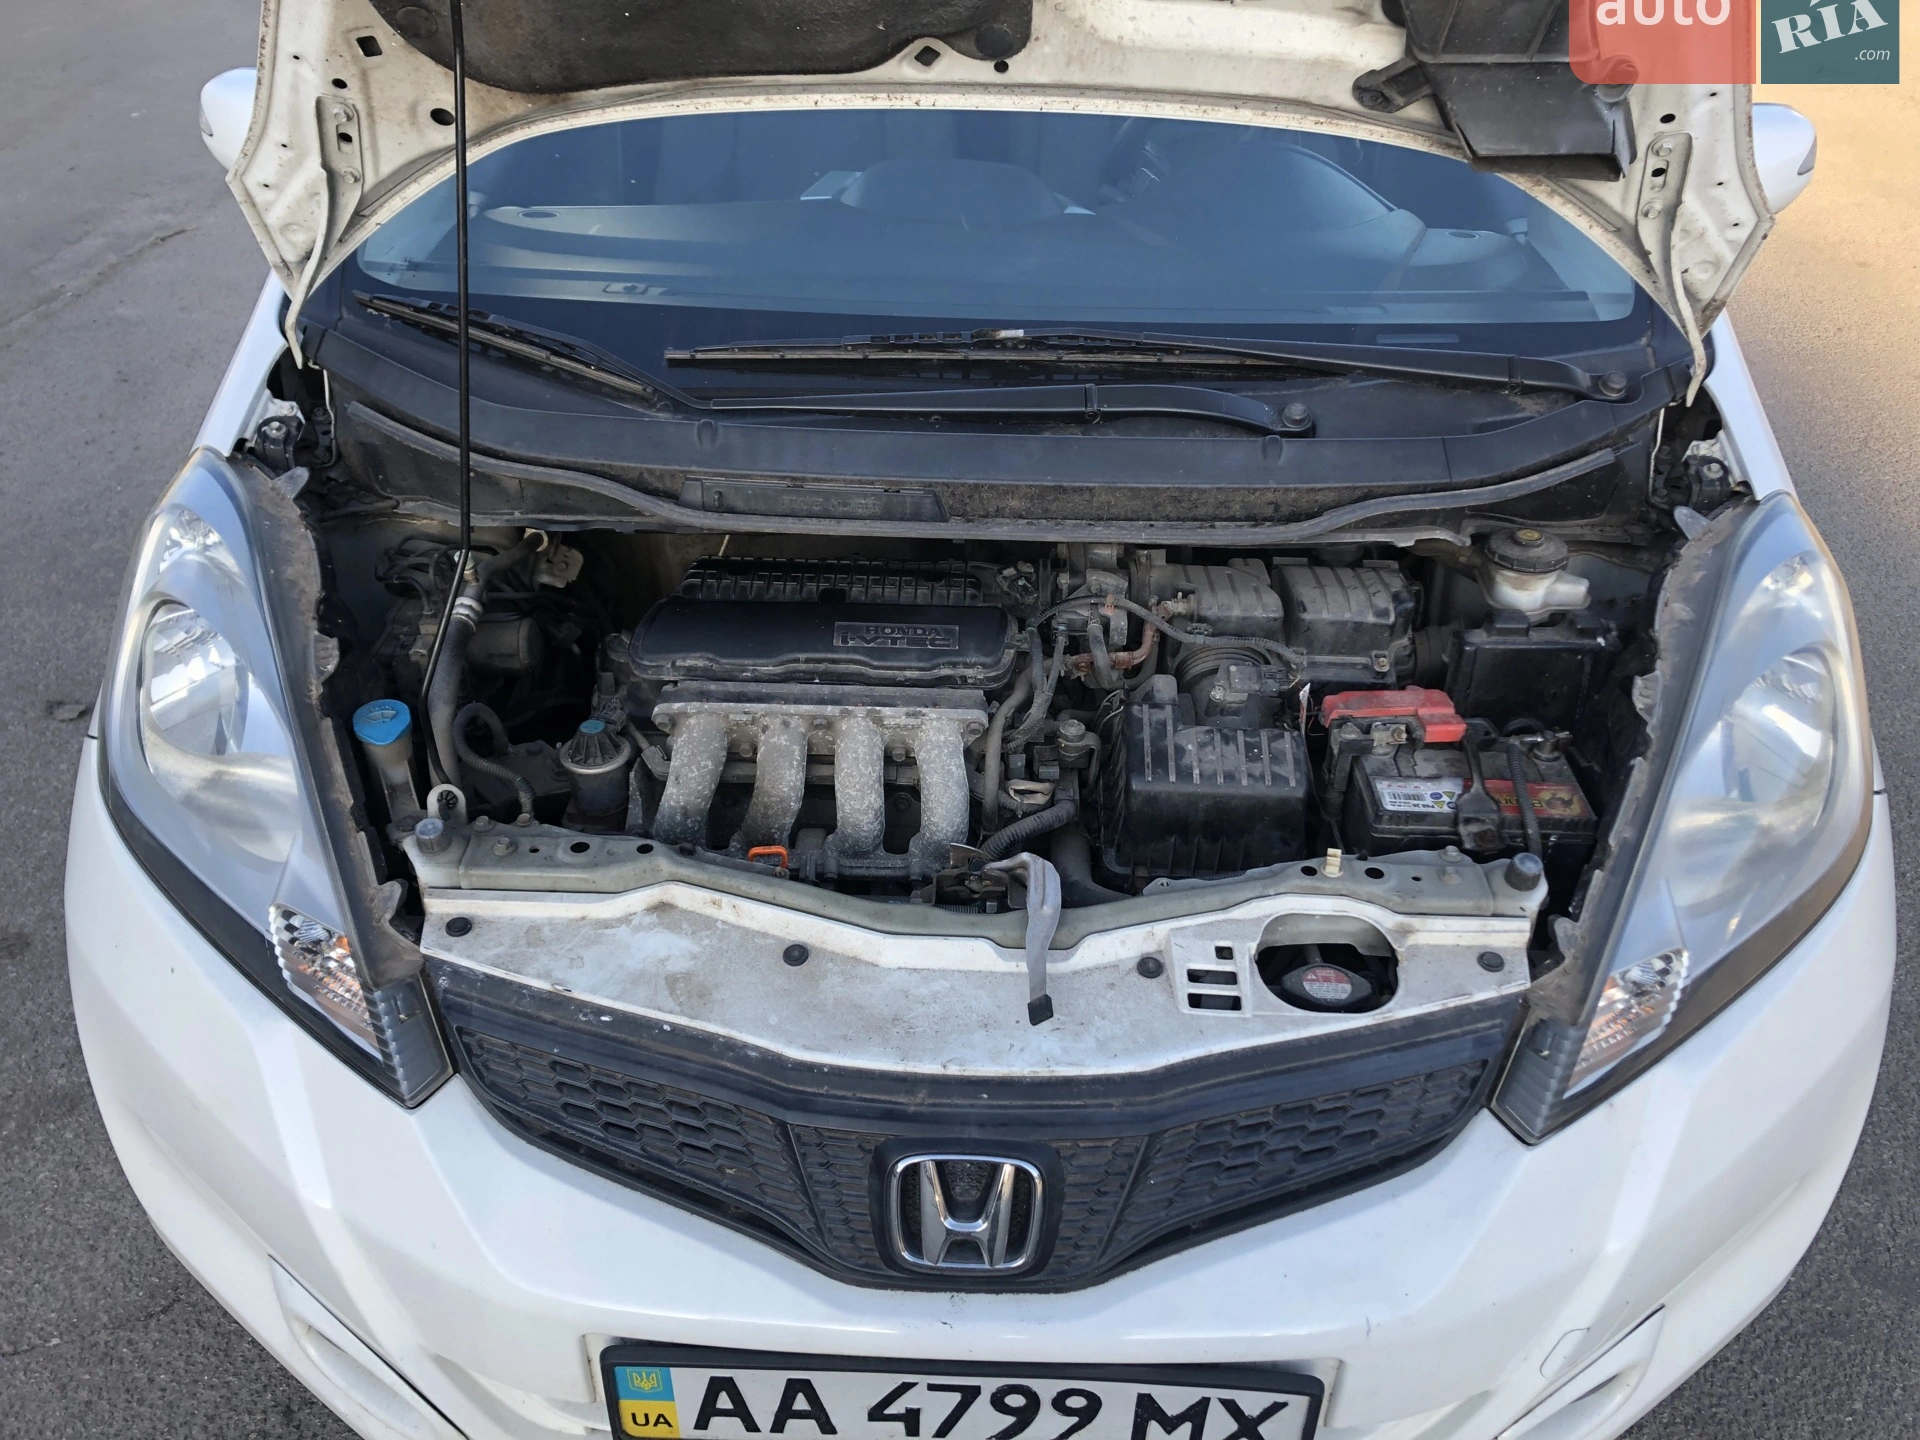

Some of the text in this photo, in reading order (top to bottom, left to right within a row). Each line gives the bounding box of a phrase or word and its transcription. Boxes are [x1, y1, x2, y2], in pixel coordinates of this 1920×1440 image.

[865, 626, 943, 637] HONDA
[841, 632, 952, 648] i-VTEC
[693, 1375, 1289, 1440] AA 4799 MX
[631, 1412, 674, 1428] UA
